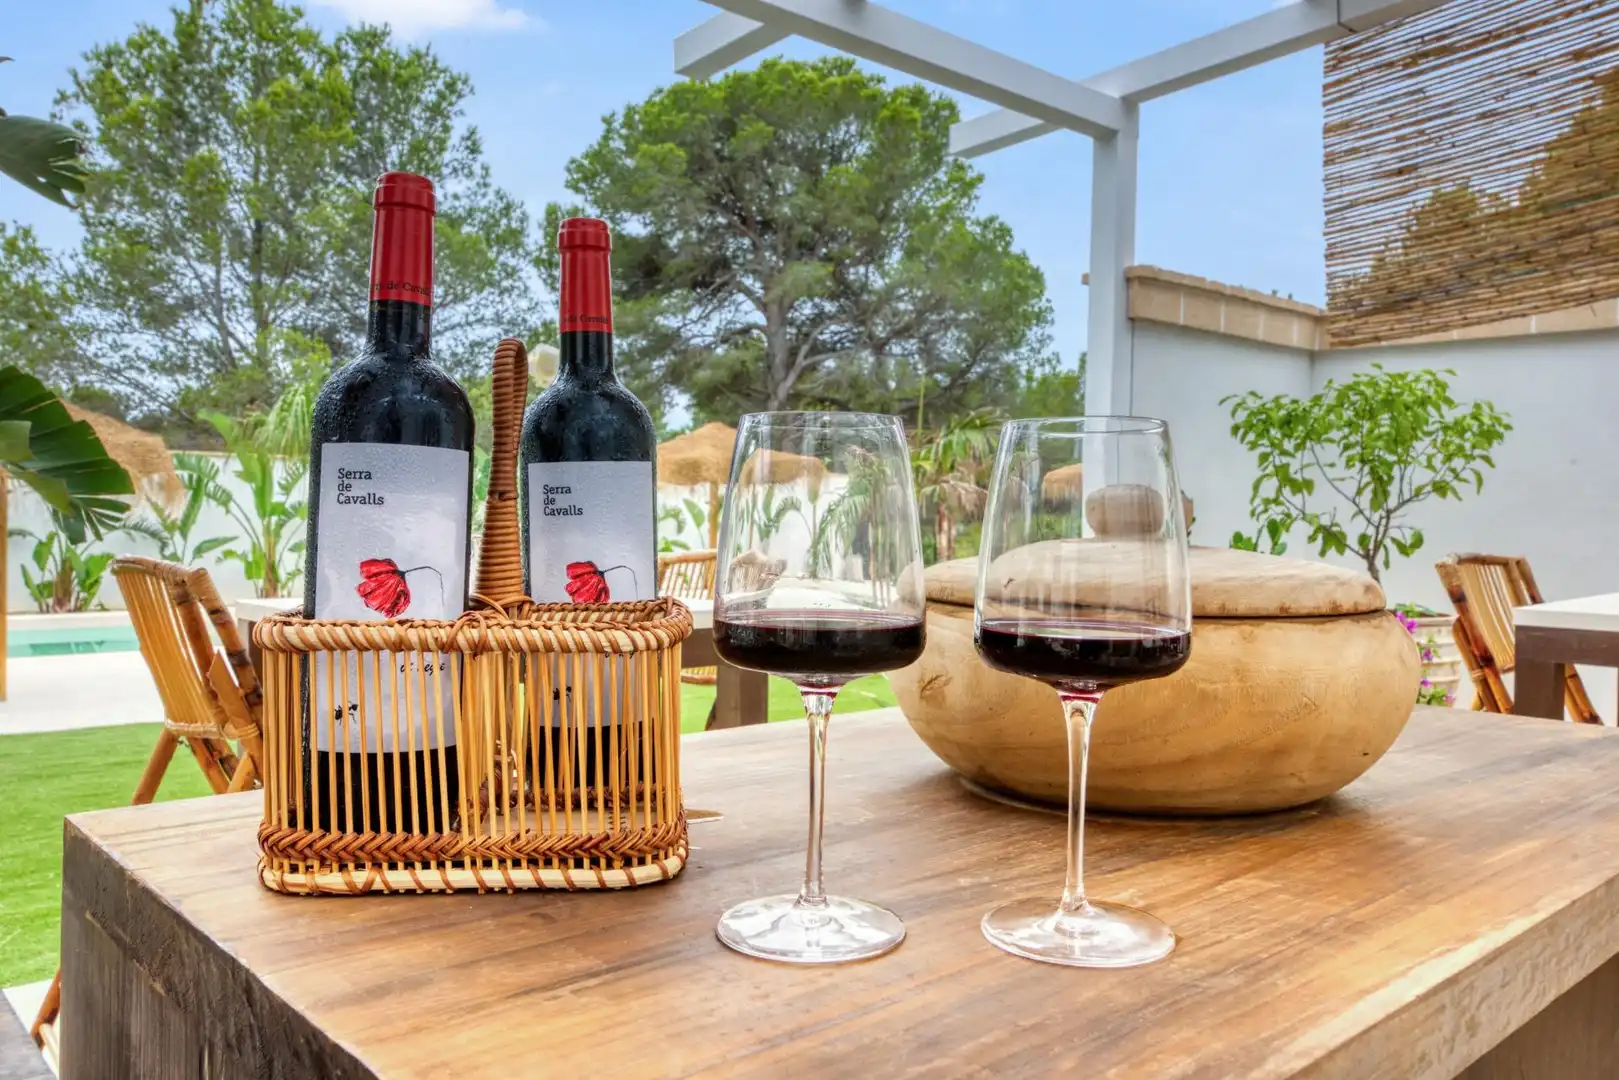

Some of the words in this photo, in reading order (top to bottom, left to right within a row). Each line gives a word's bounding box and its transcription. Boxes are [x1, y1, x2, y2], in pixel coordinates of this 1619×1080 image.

[338, 468, 372, 480] Serra
[337, 480, 352, 492] de
[543, 484, 572, 495] Serra
[337, 493, 384, 505] Cavalls
[543, 495, 556, 505] de
[543, 505, 583, 516] Cavalls
